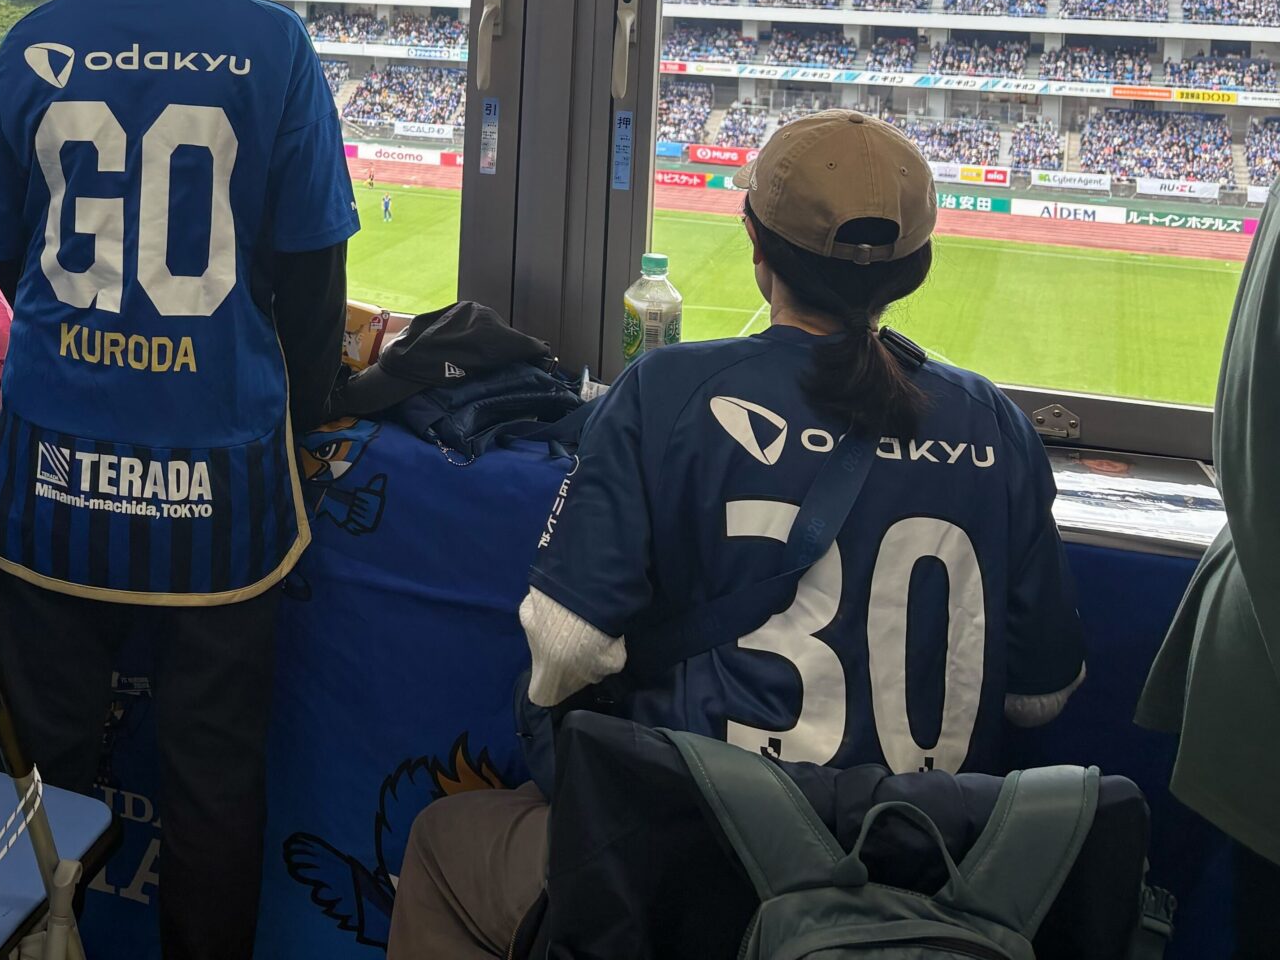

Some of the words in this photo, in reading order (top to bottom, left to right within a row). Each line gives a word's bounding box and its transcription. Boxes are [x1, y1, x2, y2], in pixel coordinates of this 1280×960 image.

[84, 43, 251, 75] odakyu
[616, 116, 631, 129] 押
[374, 148, 423, 162] docomo
[711, 150, 739, 161] MUFG
[937, 193, 992, 211] 治安田
[59, 323, 197, 372] KURODA
[801, 428, 995, 468] oakyu
[75, 451, 213, 501] TERADA
[725, 499, 985, 776] 30
